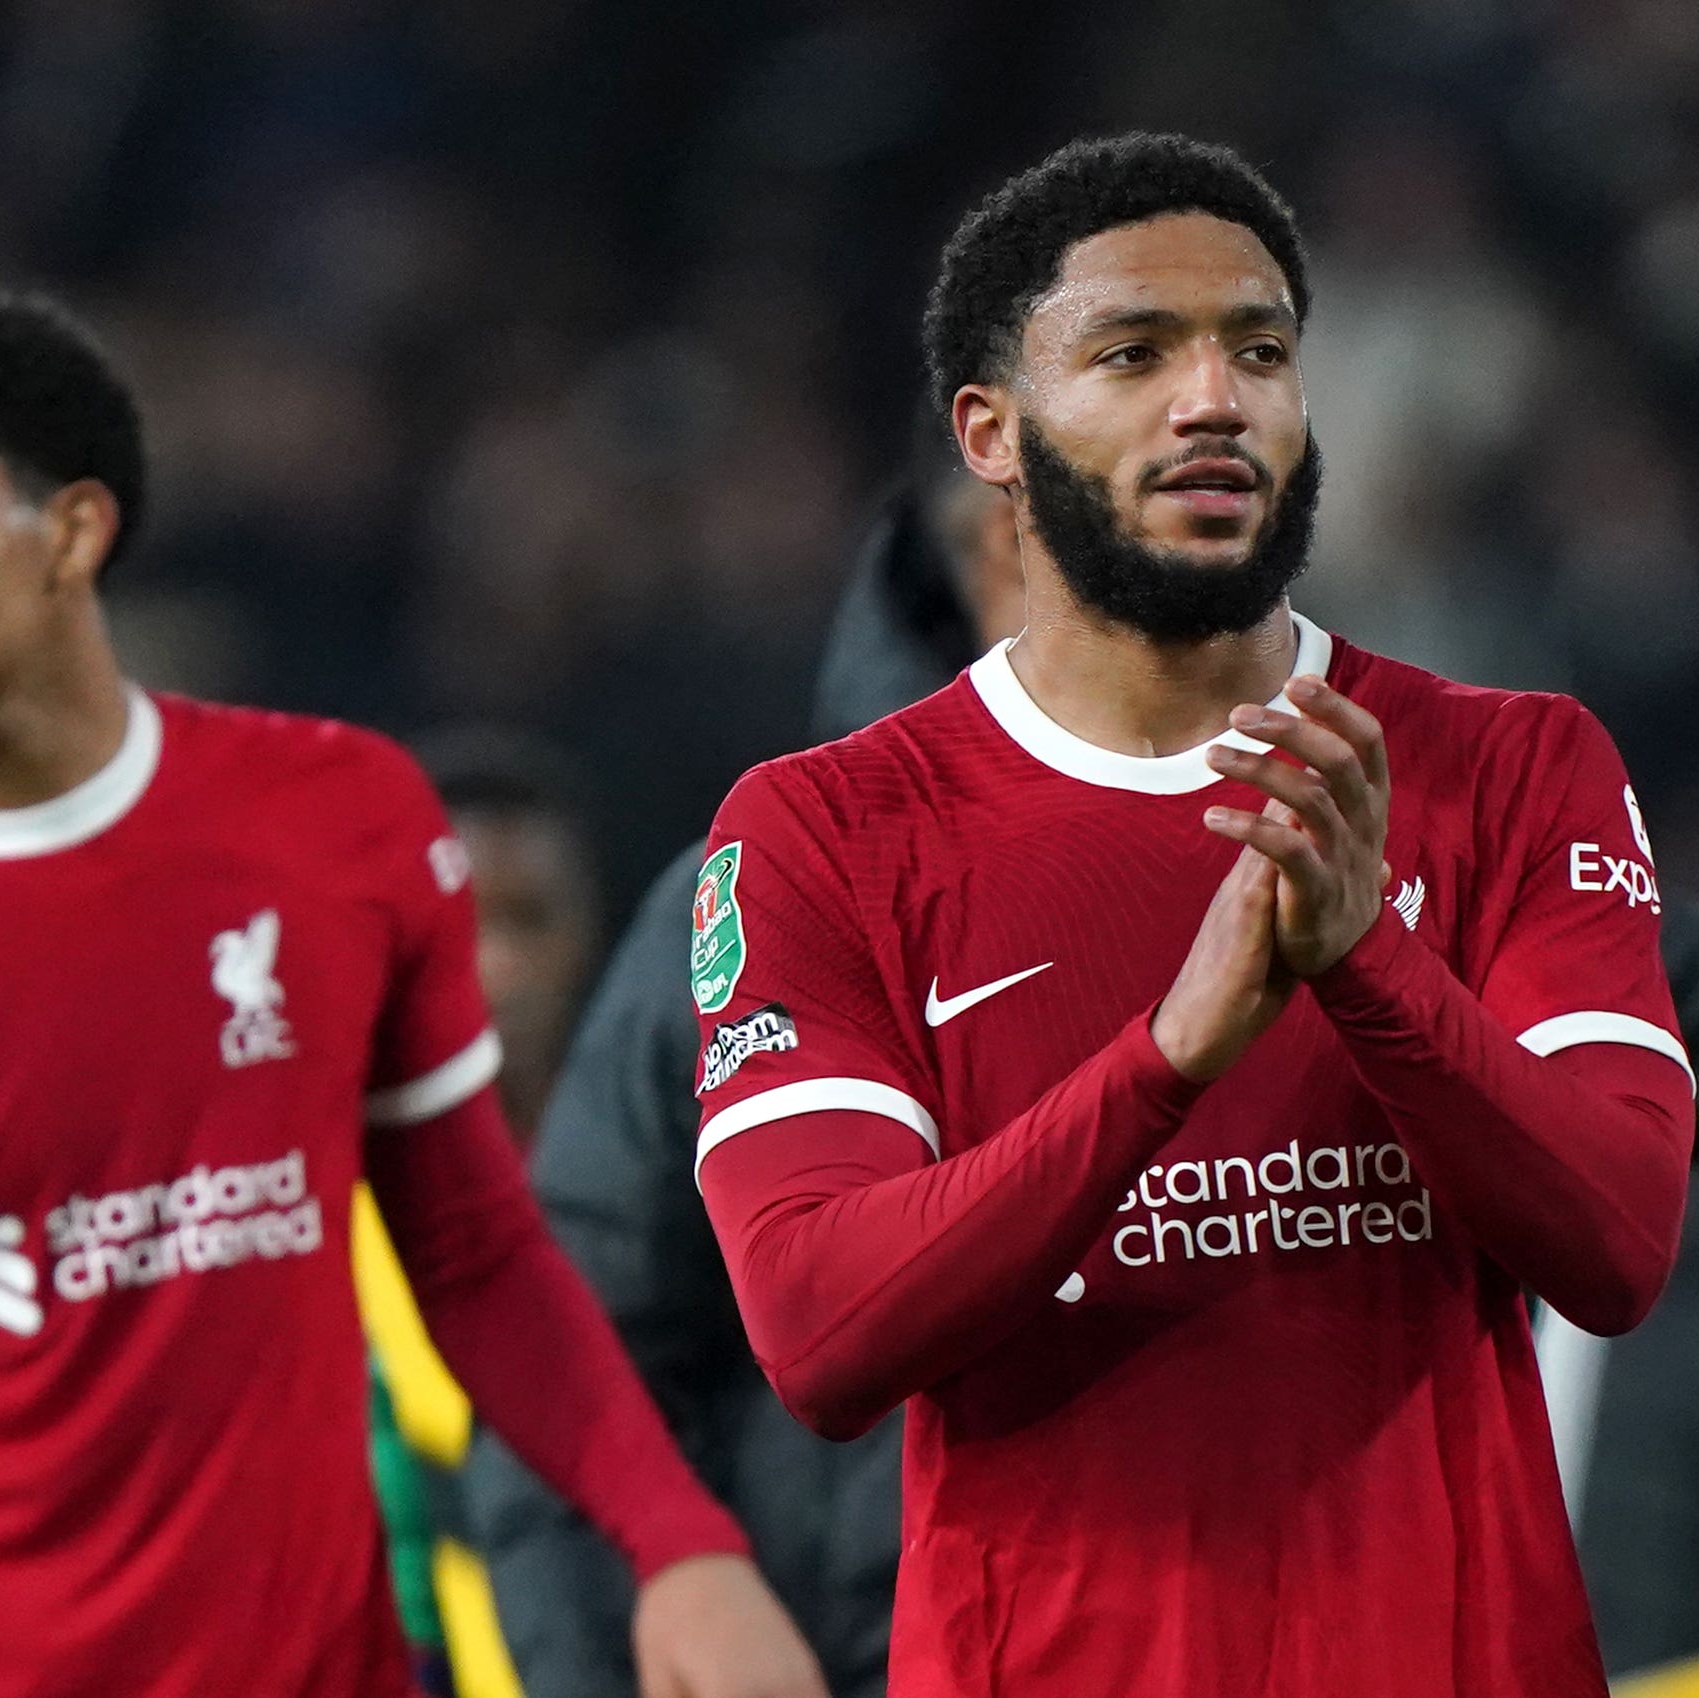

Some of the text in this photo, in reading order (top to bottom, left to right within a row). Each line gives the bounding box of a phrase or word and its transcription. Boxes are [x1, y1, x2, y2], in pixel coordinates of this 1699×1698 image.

[1570, 842, 1662, 915] Exp
[695, 935, 720, 971] Cup
[45, 1147, 306, 1258] standard
[1113, 1187, 1433, 1267] chartered
[53, 1196, 323, 1302] chartered
